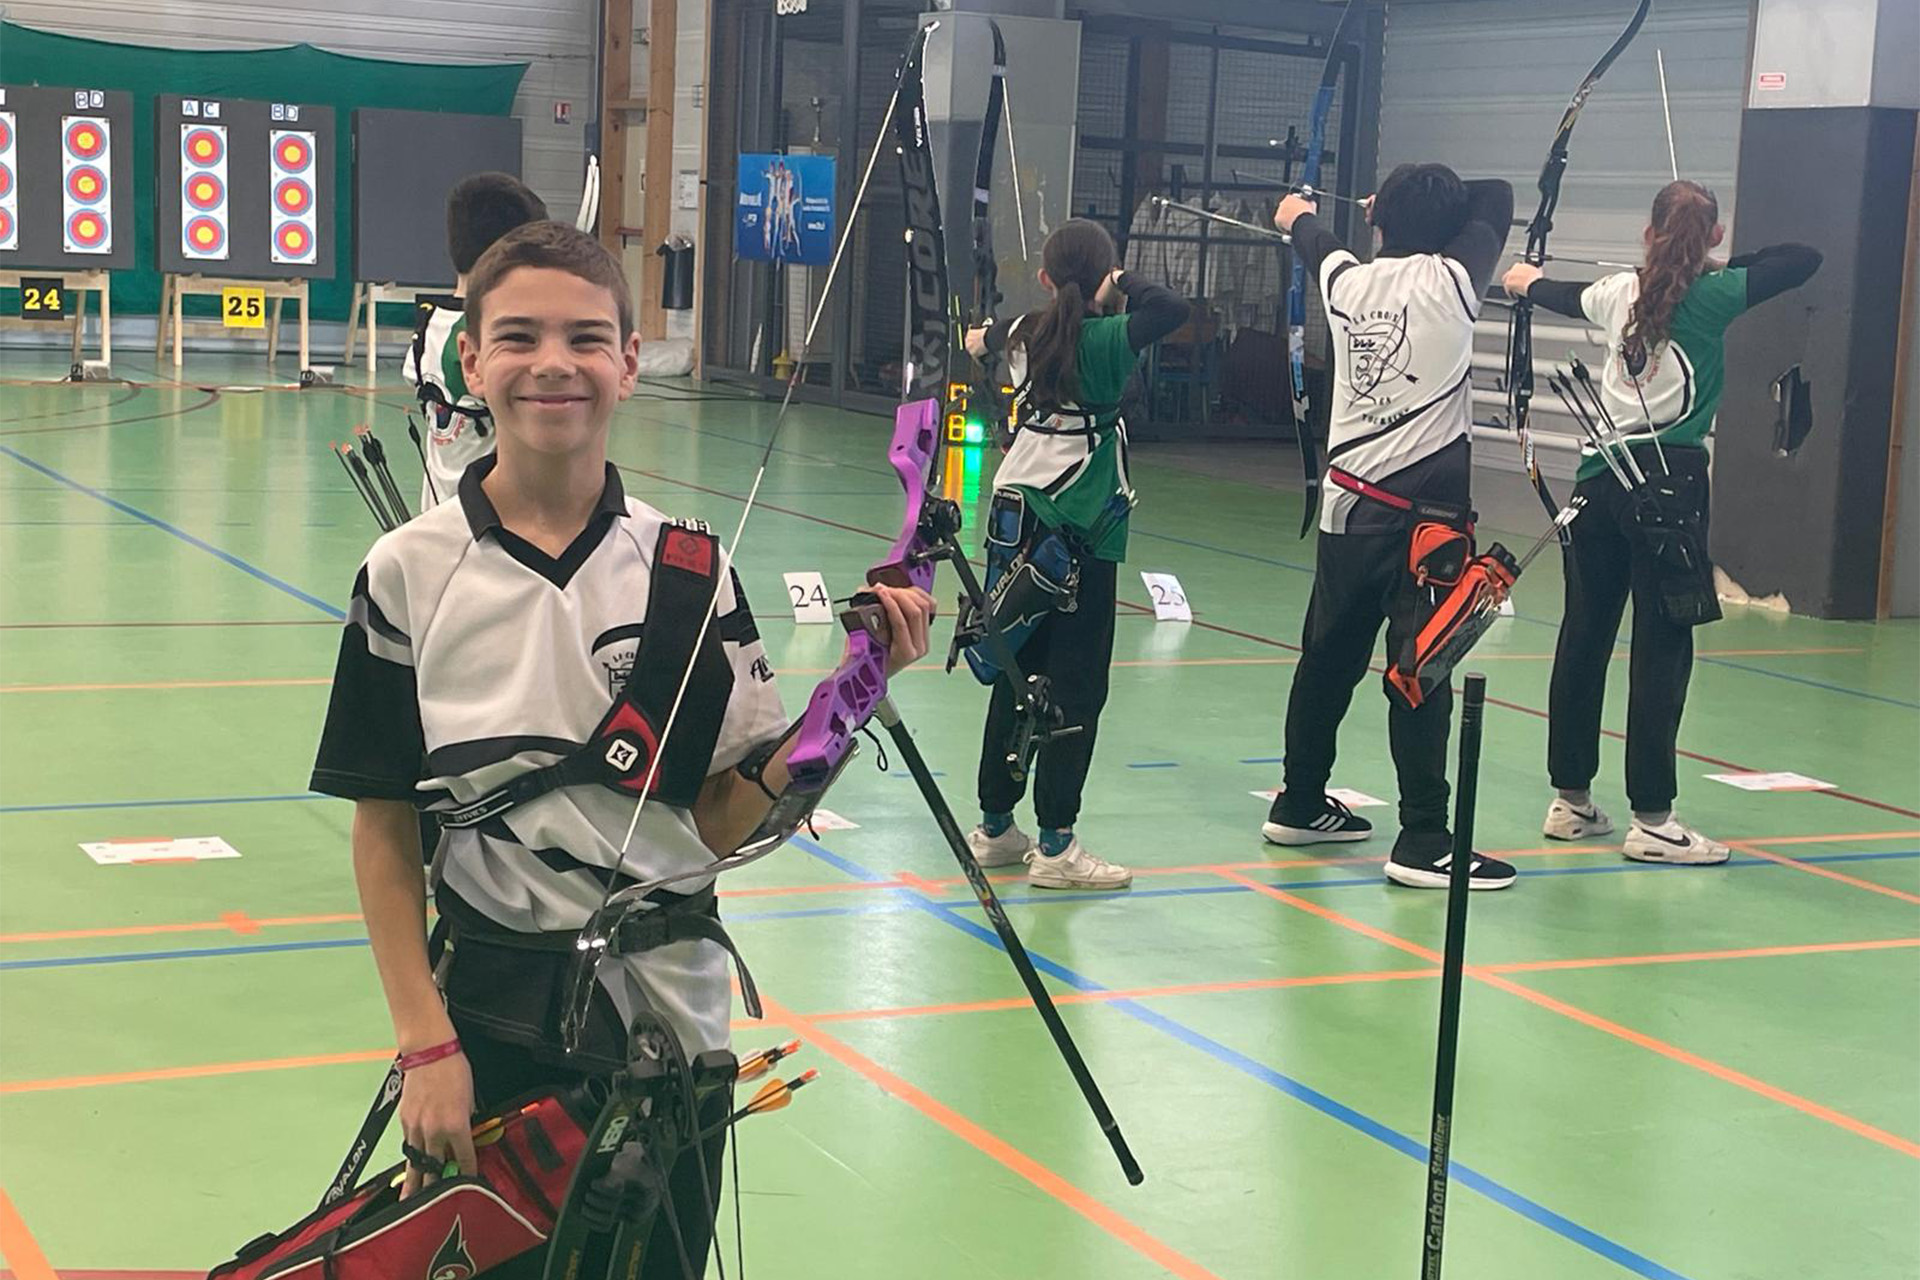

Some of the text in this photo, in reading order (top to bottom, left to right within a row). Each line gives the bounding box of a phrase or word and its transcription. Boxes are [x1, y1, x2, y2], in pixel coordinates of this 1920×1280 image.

[24, 288, 60, 310] 24
[228, 296, 260, 318] 25
[790, 584, 827, 608] 24
[1151, 584, 1184, 606] 25
[1426, 1179, 1444, 1250] Carbon
